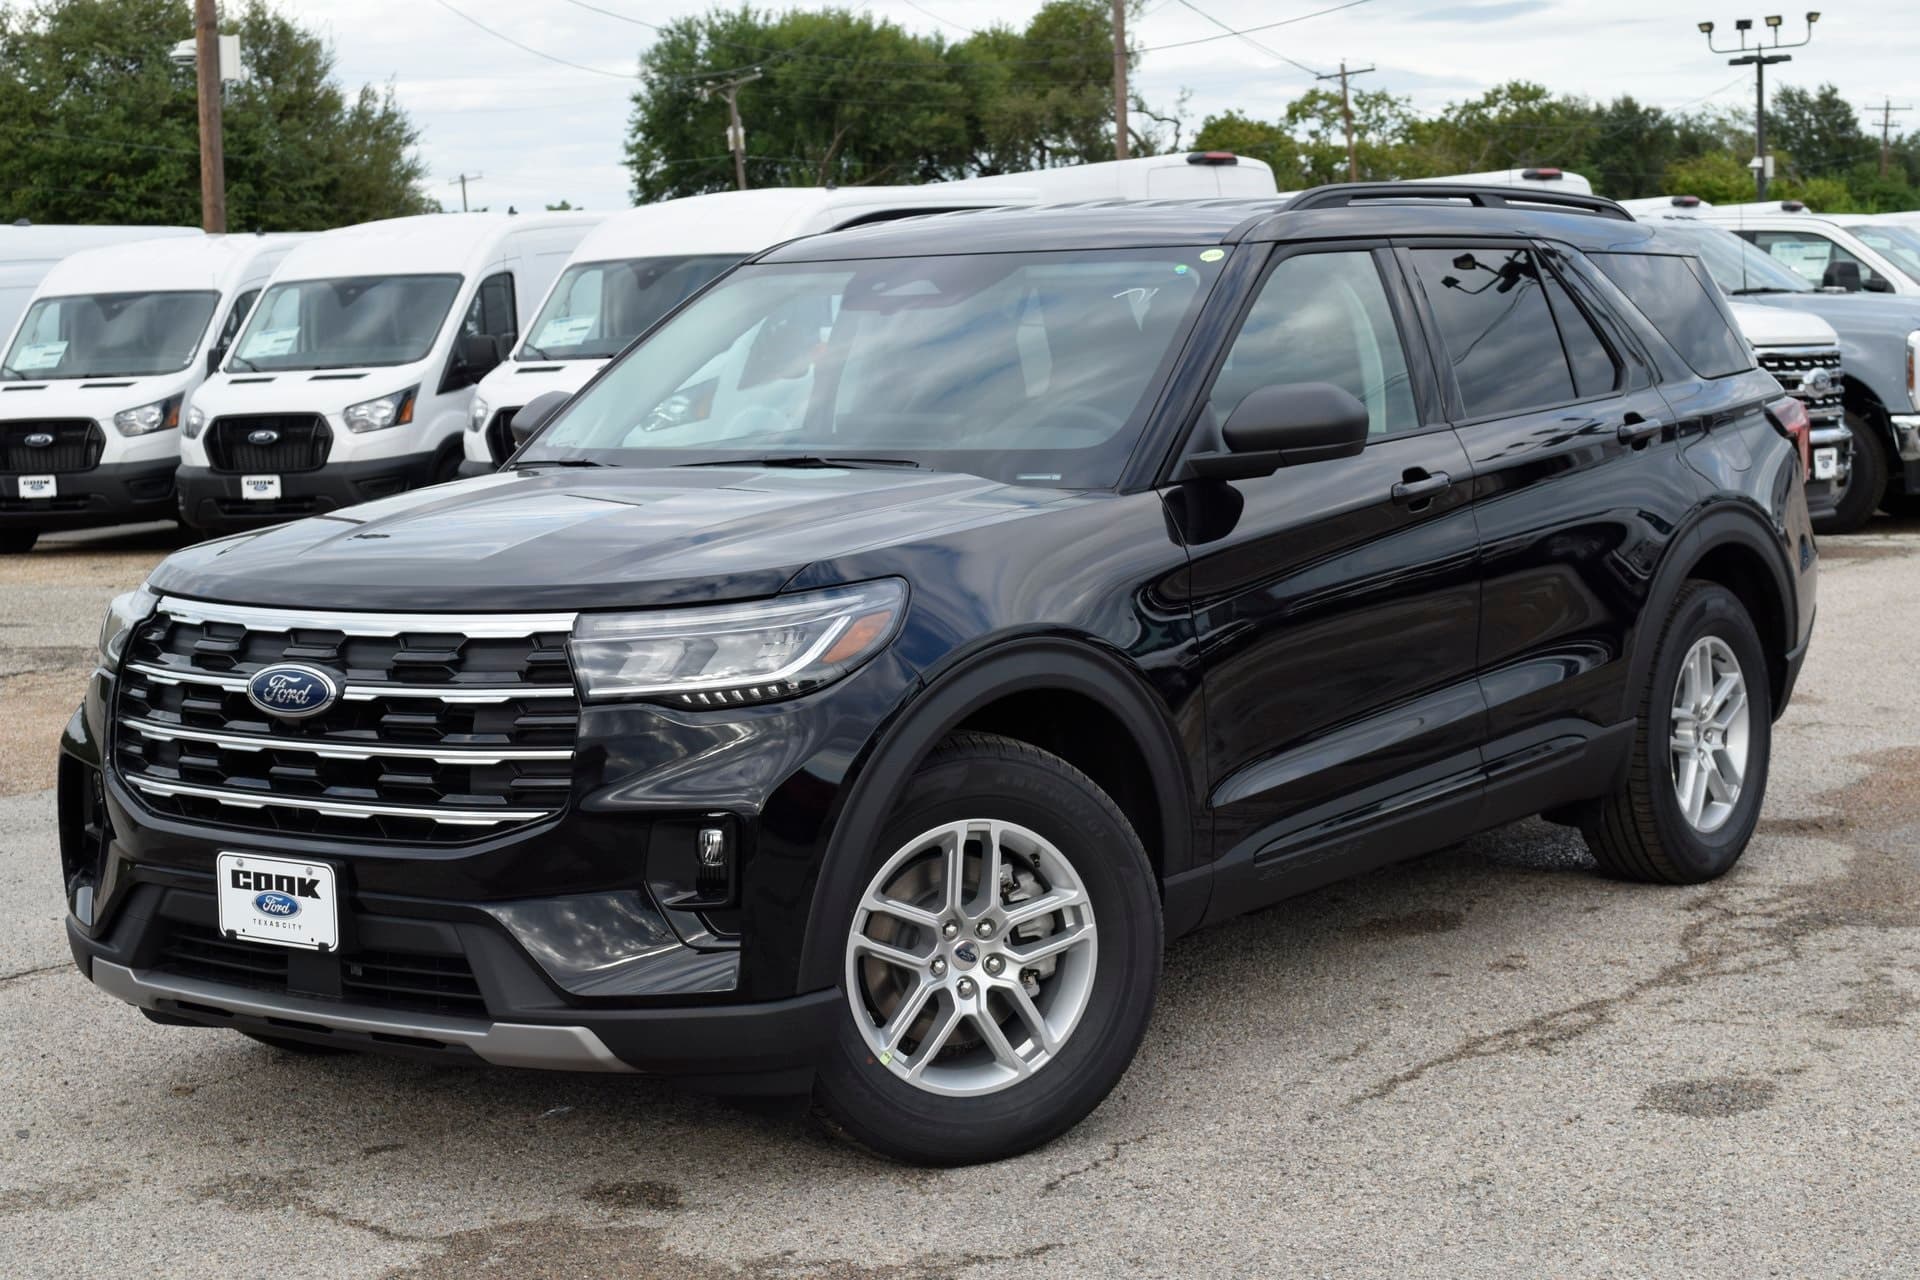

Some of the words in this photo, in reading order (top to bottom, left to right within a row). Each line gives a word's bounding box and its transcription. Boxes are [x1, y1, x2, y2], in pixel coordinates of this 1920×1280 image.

[263, 674, 313, 705] Ford
[231, 869, 322, 900] COOK
[262, 895, 290, 914] Ford
[253, 918, 280, 928] TEXAS
